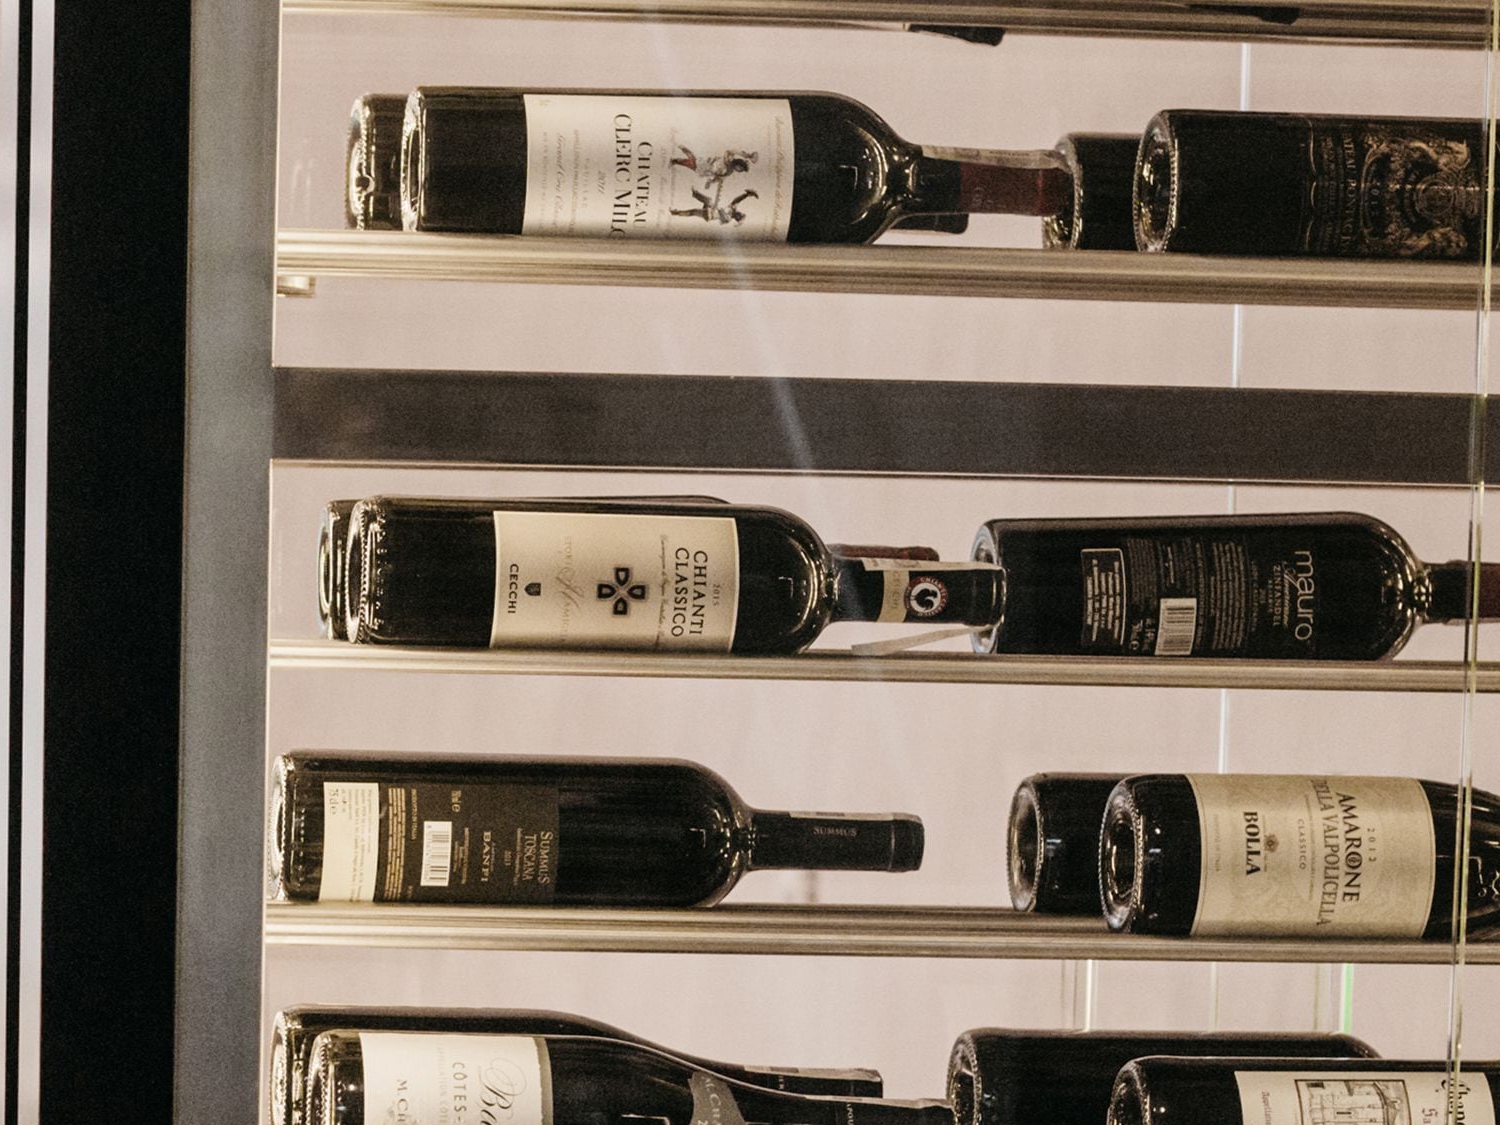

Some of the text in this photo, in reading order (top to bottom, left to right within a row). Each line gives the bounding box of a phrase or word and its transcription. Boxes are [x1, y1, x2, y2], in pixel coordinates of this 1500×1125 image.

[613, 114, 633, 182] CLERC
[632, 141, 653, 229] CHATEAU
[508, 563, 520, 614] CECCHI
[670, 547, 690, 637] CLASSICO
[689, 550, 709, 635] CHIANTI
[1271, 564, 1282, 627] ZINFANDEL
[1293, 550, 1316, 641] mauro
[480, 831, 491, 882] BANFI
[521, 834, 537, 880] TOSCANA
[537, 831, 554, 884] SUMMUS
[814, 826, 857, 837] SUMMUS
[1242, 811, 1262, 876] BOLLA
[1297, 818, 1307, 870] CLASSICO
[1335, 792, 1363, 902] AMARONE
[1315, 814, 1341, 926] VALPOLICELLA
